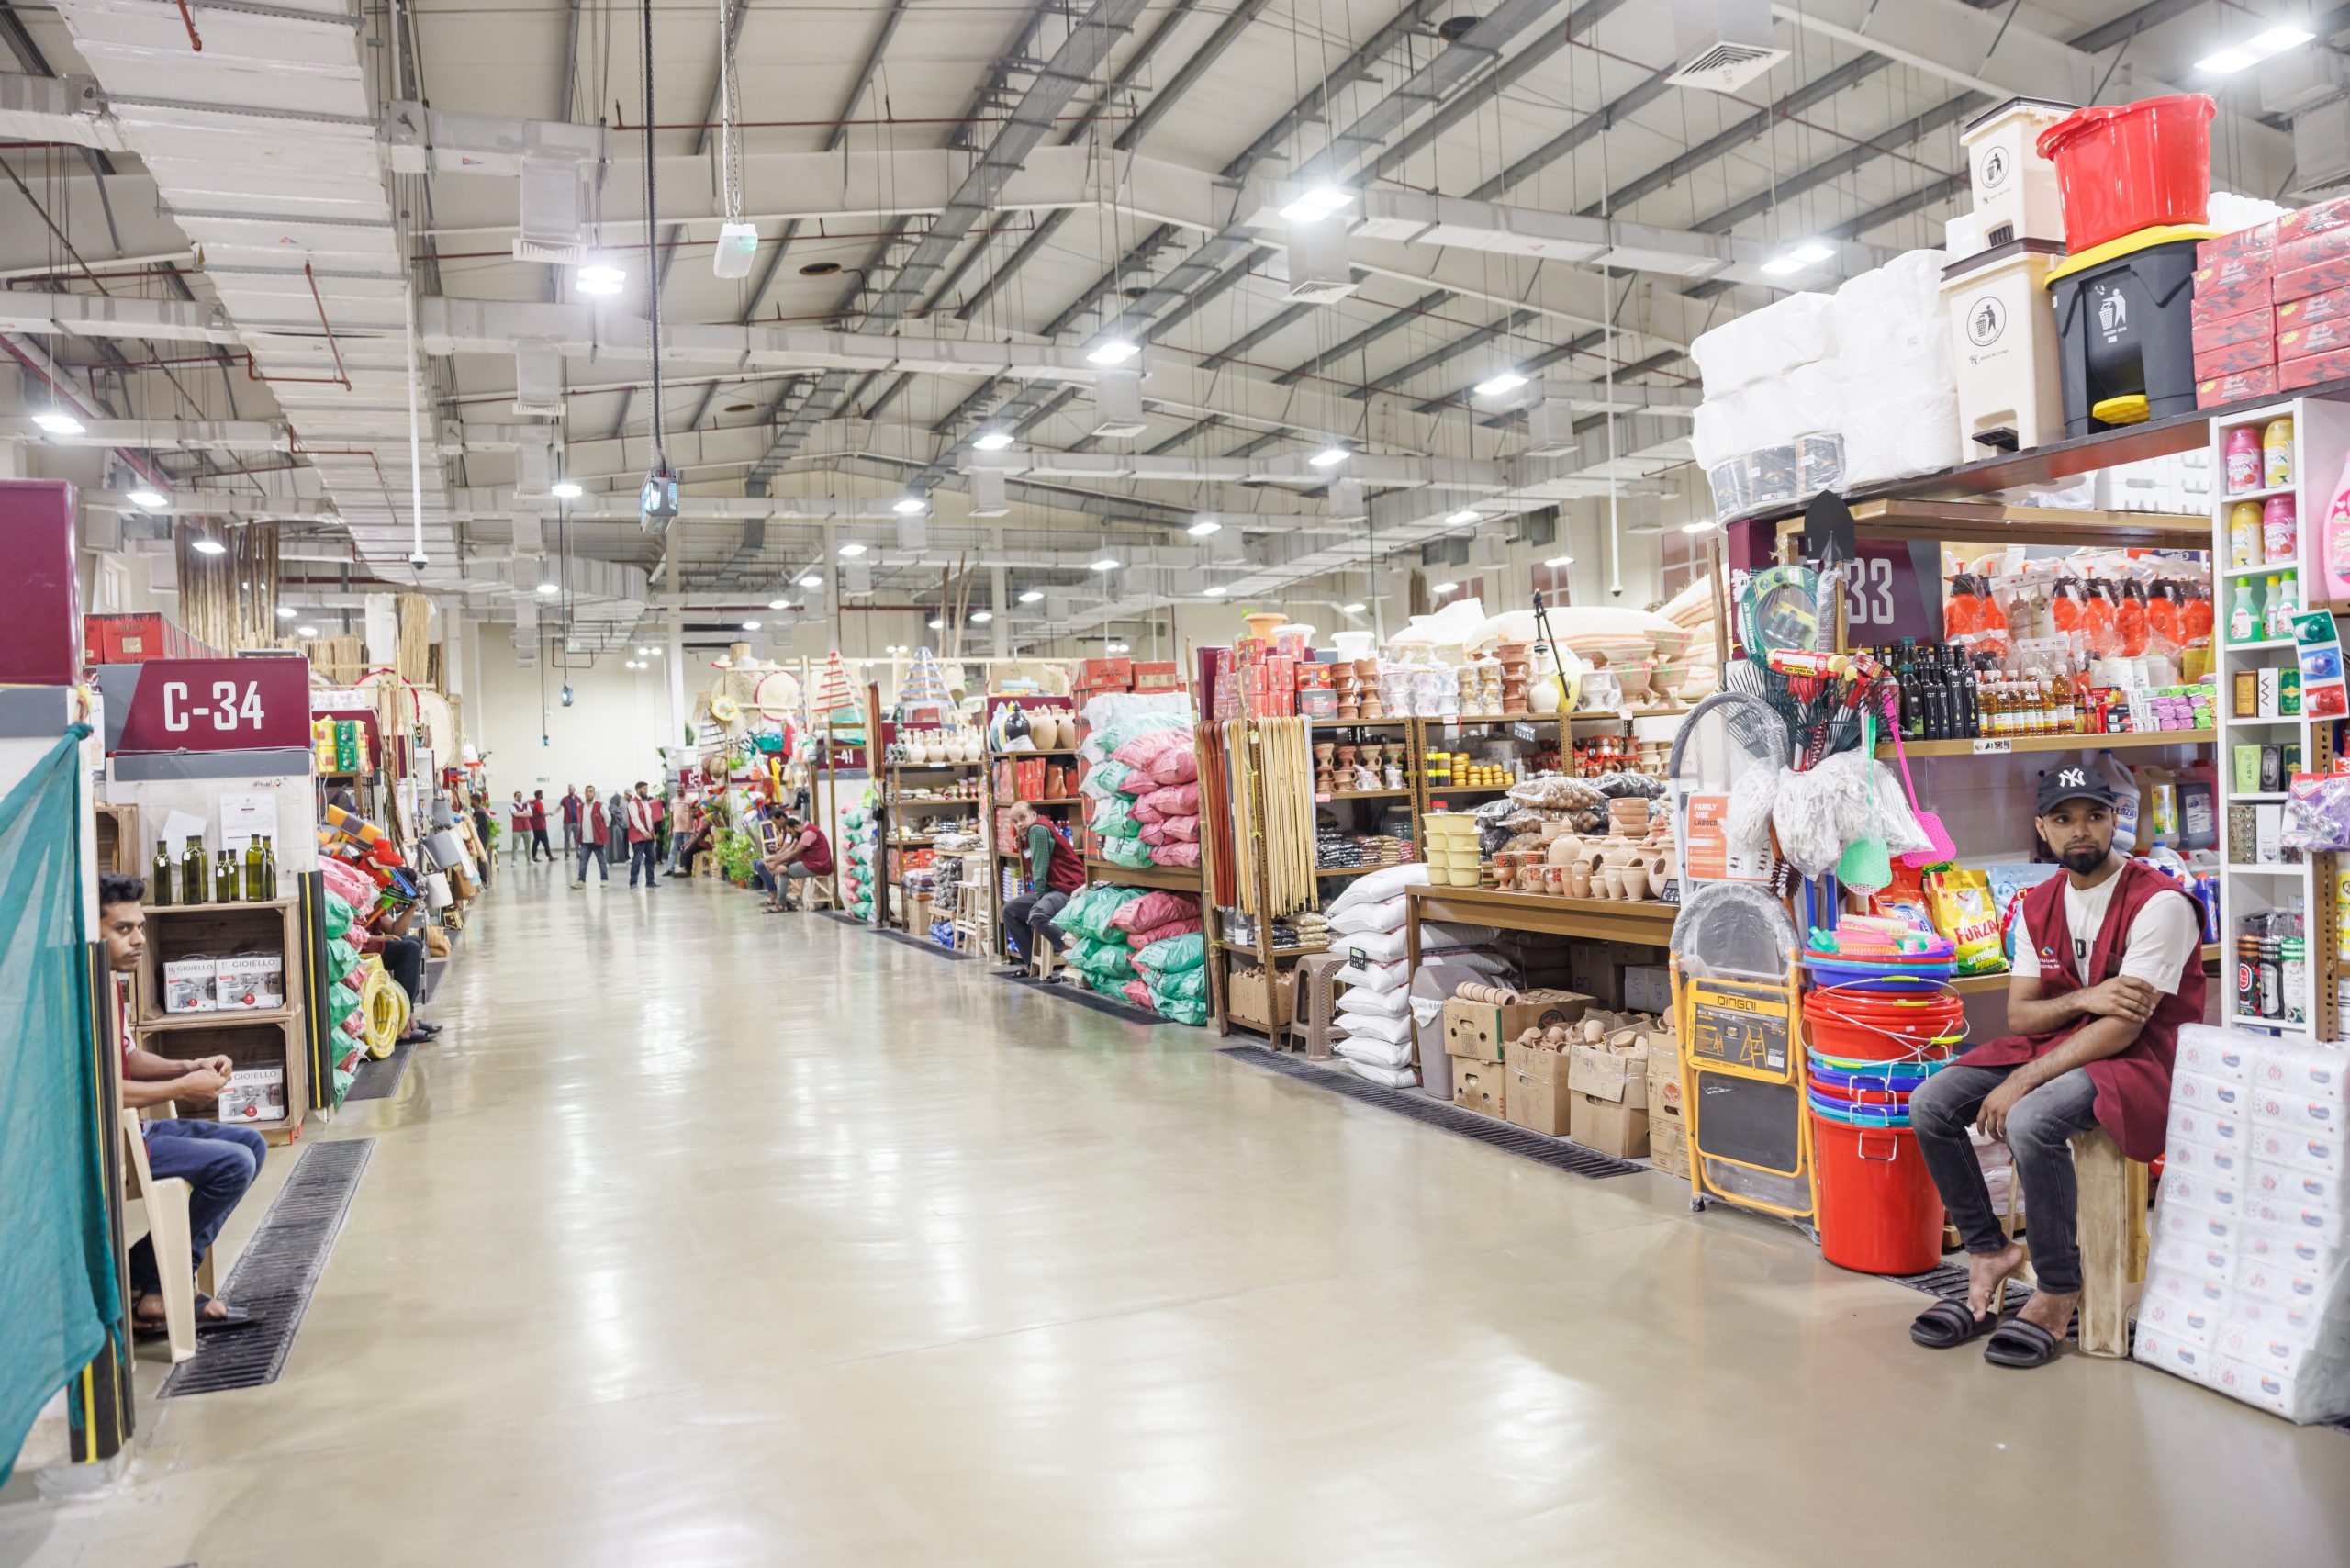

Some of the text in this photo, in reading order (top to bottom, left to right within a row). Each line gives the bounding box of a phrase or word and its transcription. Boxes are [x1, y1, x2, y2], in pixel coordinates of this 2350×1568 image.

[163, 680, 265, 732] C-34
[2058, 767, 2087, 788] NY
[1953, 919, 1999, 946] FURZA
[176, 964, 213, 972] GIOIELLO
[232, 959, 275, 968] GIOIELLO
[233, 1070, 277, 1081] GIOIELLO
